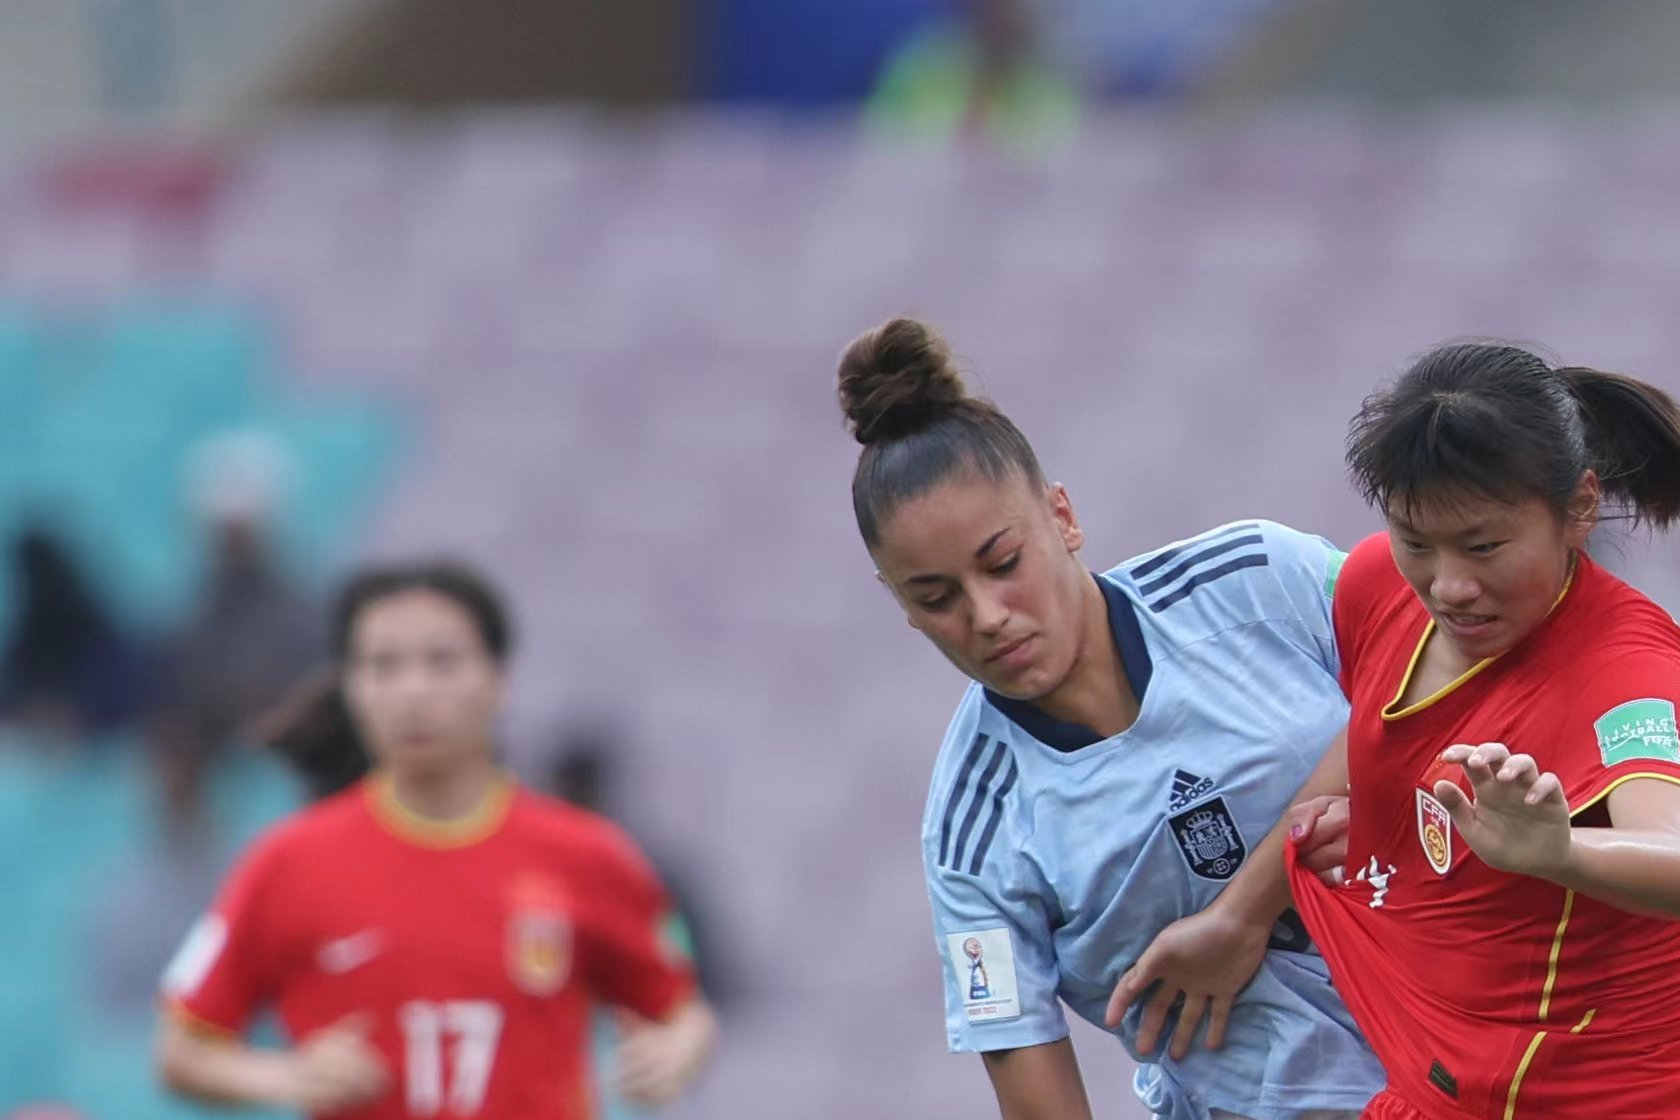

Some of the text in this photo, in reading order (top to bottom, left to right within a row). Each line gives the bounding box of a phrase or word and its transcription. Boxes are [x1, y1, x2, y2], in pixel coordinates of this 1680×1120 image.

[1170, 777, 1214, 812] adidas
[1422, 797, 1446, 826] CFA
[402, 999, 502, 1117] 17
